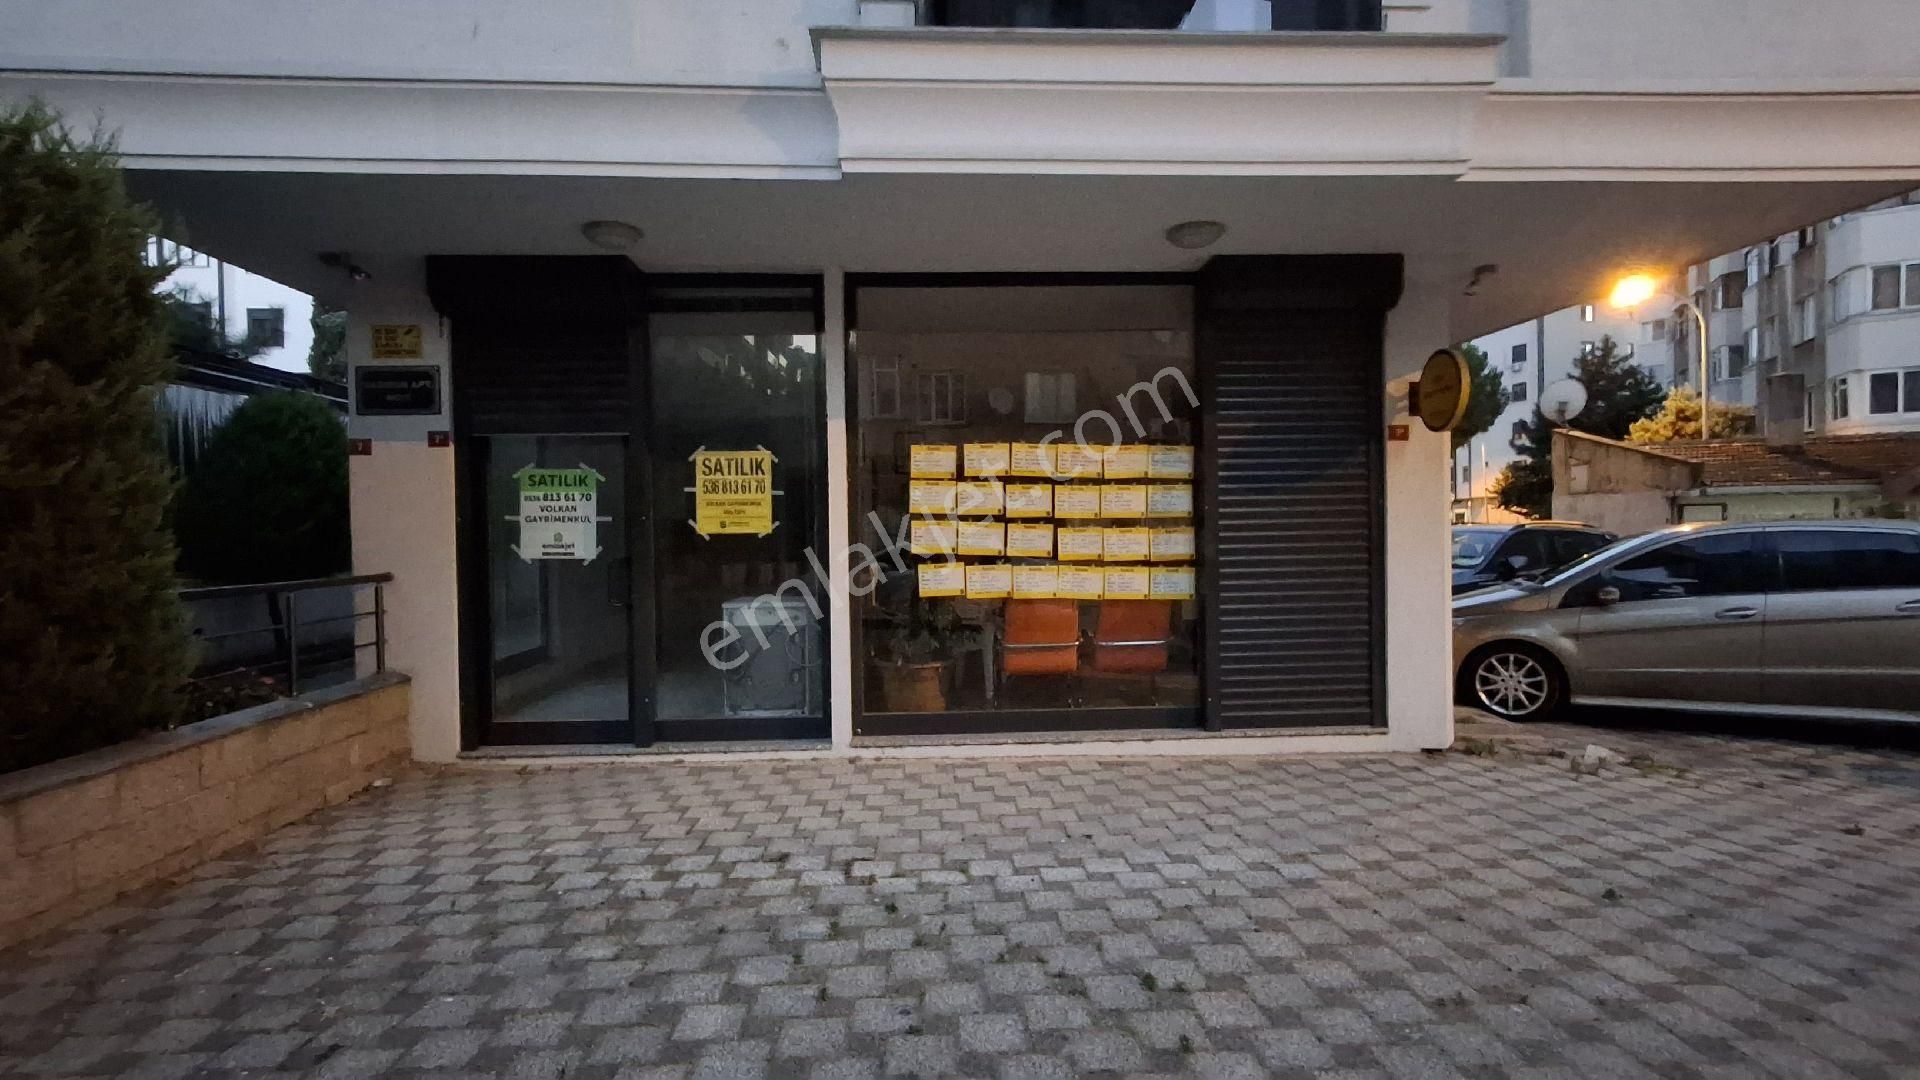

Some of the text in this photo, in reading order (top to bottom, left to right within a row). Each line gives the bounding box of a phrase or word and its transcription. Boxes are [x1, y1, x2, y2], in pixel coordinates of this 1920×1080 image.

[702, 457, 766, 476] SATILIK
[528, 474, 588, 487] SATILIK
[703, 480, 766, 495] 536 813 61 70
[542, 492, 561, 501] 813
[564, 492, 576, 501] 61
[579, 492, 592, 501] 70
[539, 505, 577, 513] VOLKAN
